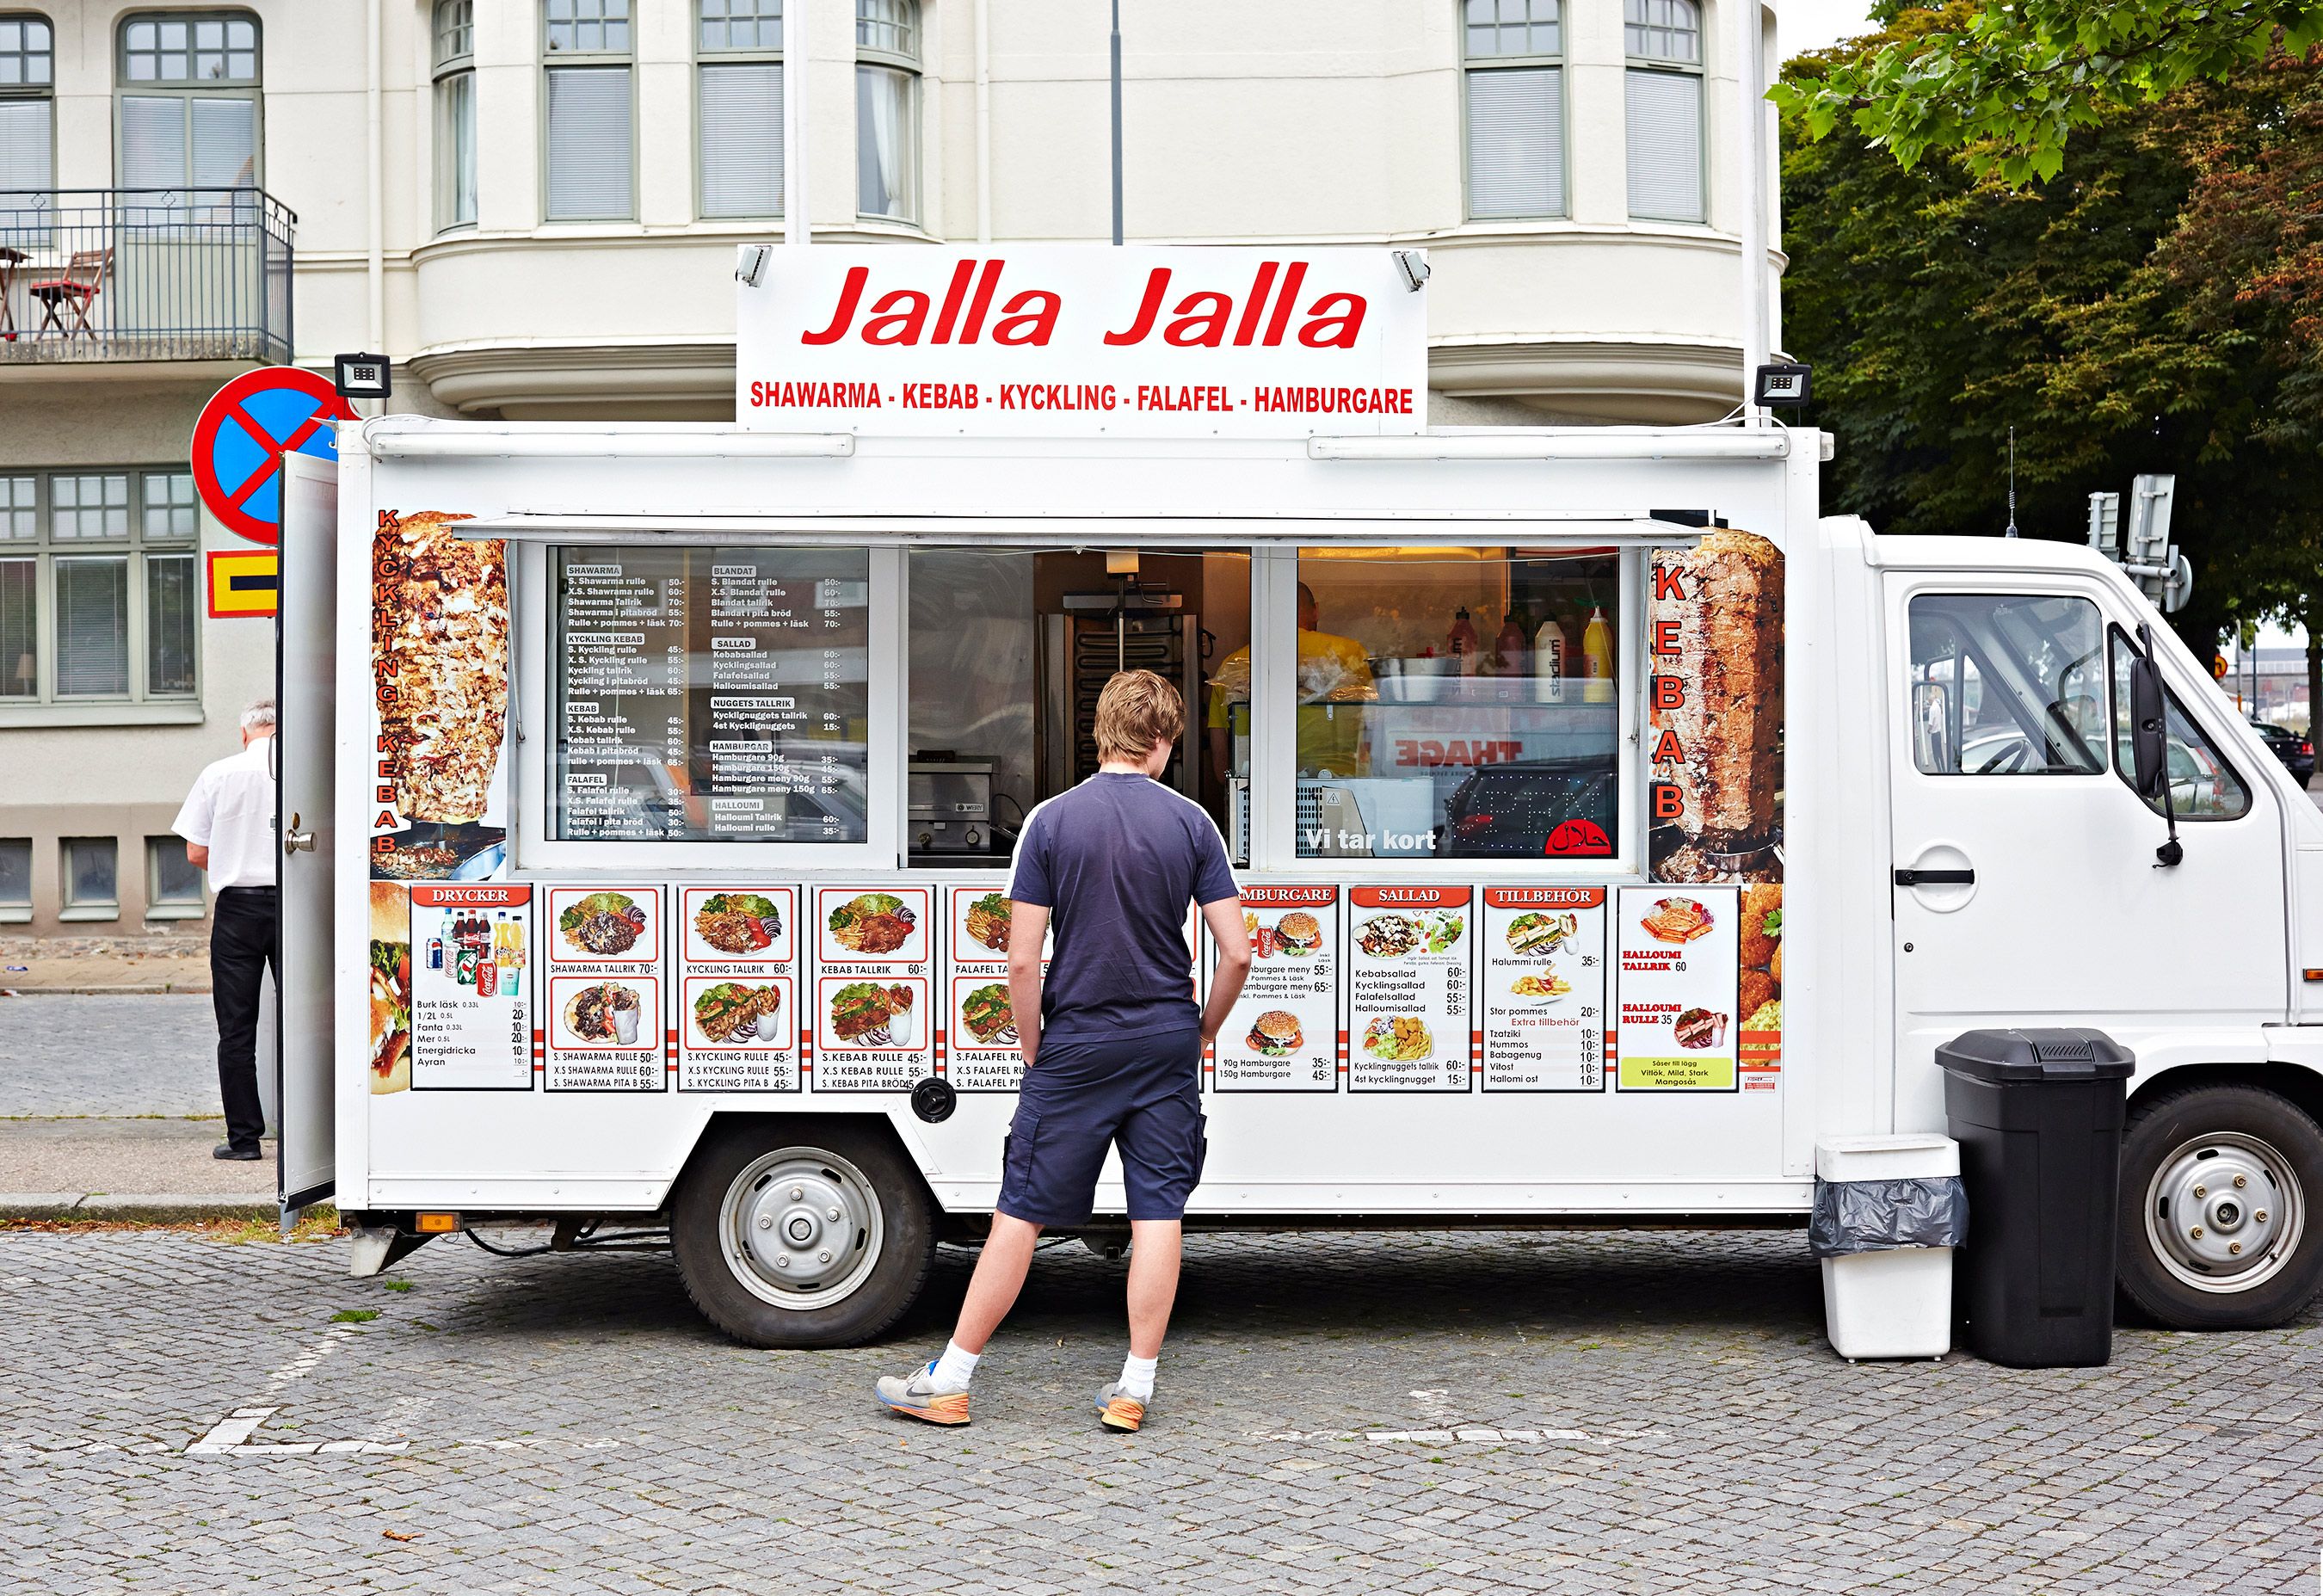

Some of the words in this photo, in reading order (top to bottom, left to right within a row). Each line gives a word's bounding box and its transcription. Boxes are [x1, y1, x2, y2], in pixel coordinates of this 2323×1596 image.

[801, 259, 1062, 346] Jalla
[1104, 262, 1367, 348] Jalla
[750, 382, 880, 408] SHAWARMA
[903, 384, 978, 409] KEBAB
[1000, 385, 1115, 411] KYCKLING
[1138, 386, 1233, 412] FALAFEL
[1254, 387, 1413, 414] HAMBURGARE
[376, 509, 399, 703] KYCKLING
[568, 667, 604, 675] Kyckling
[1550, 639, 1560, 696] stadium
[1654, 566, 1685, 818] KEBAB
[374, 735, 398, 853] KEBAB
[1306, 829, 1330, 850] Vi
[1338, 831, 1375, 850] tar
[1383, 829, 1437, 850] kort
[1552, 826, 1609, 851] حلال
[433, 890, 509, 902] DRYCKER
[1238, 889, 1331, 901] MBURGARE
[1378, 890, 1440, 902] SALLAD
[1496, 888, 1592, 903] TILLBEHÖR
[1582, 956, 1599, 966] 35:-
[551, 964, 602, 973] SHAWARMA
[605, 964, 636, 973] TALLRIK
[638, 964, 657, 974] 70:-
[687, 965, 730, 974] KYCKLING
[733, 965, 764, 974] TALLRIK
[773, 964, 793, 975] 60:-
[822, 965, 853, 975] KEBAB
[855, 965, 891, 975] TALLRIK
[908, 964, 927, 975] 60:-
[956, 965, 995, 974] FALAFEL
[1315, 965, 1332, 975] 55:-
[1675, 962, 1686, 971] 60
[1448, 967, 1465, 977] 60:-
[1315, 982, 1332, 992] 65:-
[1356, 982, 1425, 990] Kycklingsallad
[1447, 980, 1465, 989] 60:-
[1447, 993, 1465, 1002] 55:-
[1447, 1005, 1465, 1014] 55:-
[1581, 1007, 1599, 1017] 20:-
[1661, 1015, 1672, 1024] 35
[512, 1022, 527, 1032] 10:-
[511, 1032, 527, 1043] 20:-
[1581, 1029, 1599, 1038] 10:-
[1581, 1040, 1599, 1050] 10:-
[417, 1047, 476, 1056] Energidricka
[513, 1046, 527, 1056] 10:-
[640, 1053, 657, 1063] 50:-
[773, 1053, 792, 1062] 45:-
[908, 1054, 927, 1063] 45:-
[1490, 1051, 1541, 1060] Babagenug
[1581, 1052, 1599, 1062] 10:-
[417, 1058, 446, 1067] Ayran
[1241, 1060, 1291, 1069] Hamburgare
[1312, 1058, 1330, 1068] 35:-
[1354, 1063, 1417, 1072] Kycklingnuggets
[1446, 1060, 1464, 1070] 60:-
[640, 1067, 657, 1075] 60:-
[774, 1067, 792, 1076] 55:-
[909, 1067, 927, 1076] 55:-
[1581, 1063, 1599, 1073] 10:-
[1220, 1070, 1238, 1079] 150g
[1241, 1070, 1291, 1080] Hamburgare
[1312, 1070, 1330, 1080] 45:-
[1369, 1075, 1435, 1085] kycklingnugget
[1447, 1075, 1465, 1084] 15:-
[1581, 1075, 1599, 1085] 10:-
